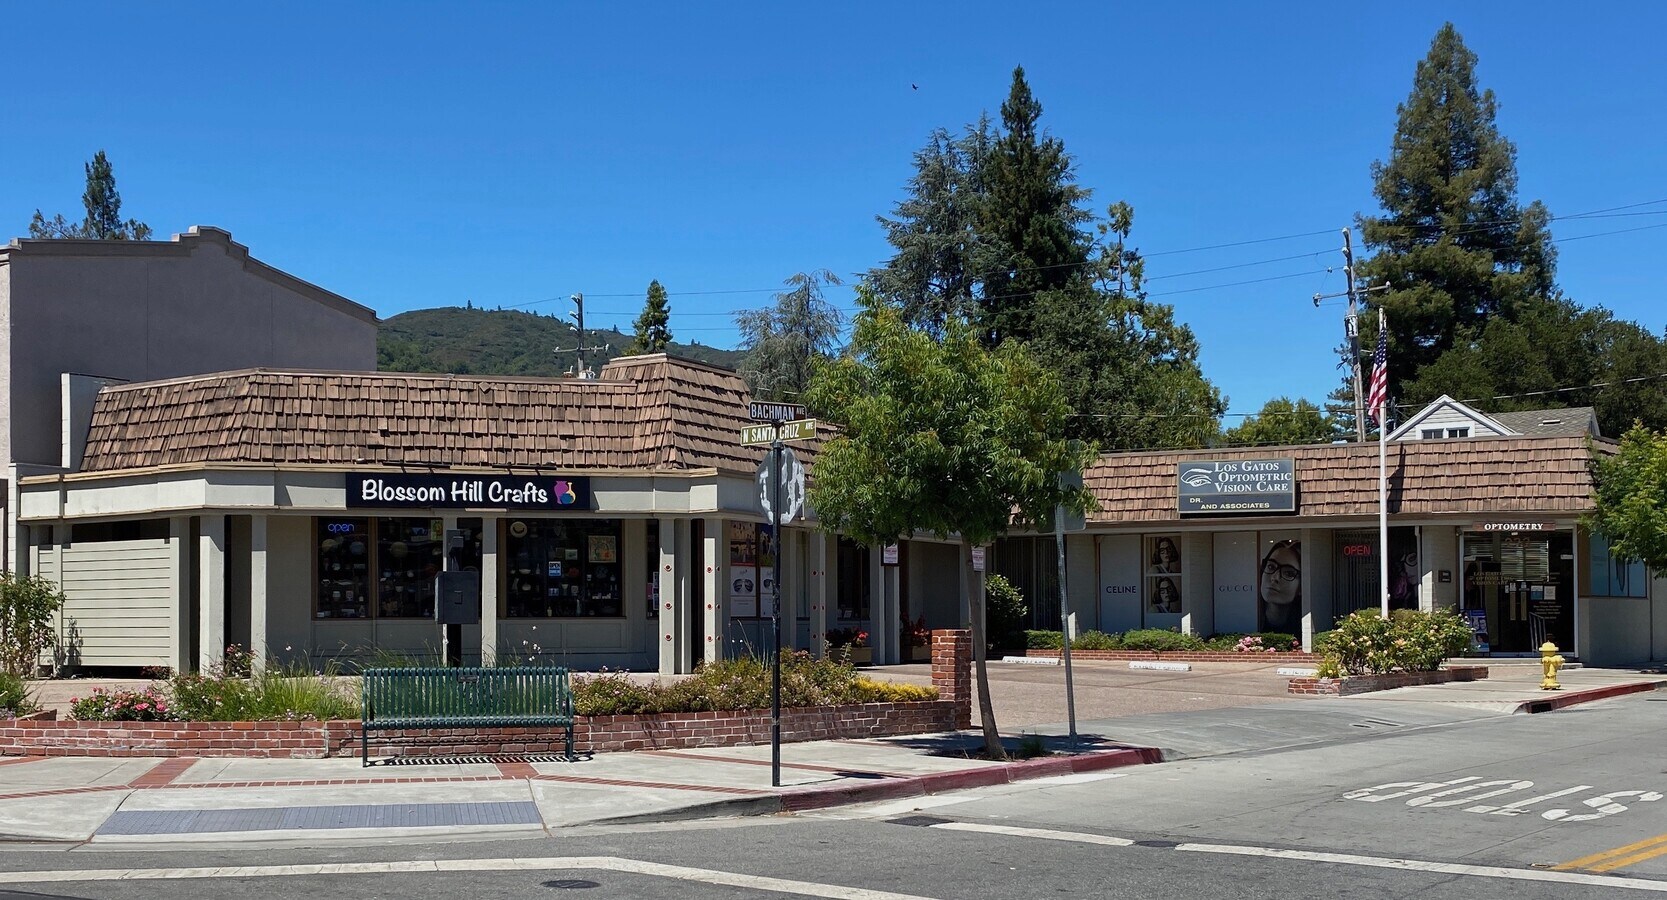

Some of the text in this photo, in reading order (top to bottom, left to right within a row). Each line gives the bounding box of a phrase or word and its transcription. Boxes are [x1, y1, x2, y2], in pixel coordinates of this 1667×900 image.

[751, 404, 805, 420] BACHMAN AVE
[743, 421, 813, 443] N SANTA CRUZ AVE
[1214, 461, 1280, 472] LOS GATOS
[1218, 472, 1292, 483] OPTOMETRIC
[361, 479, 548, 504] Blossom Hill Crafts
[1215, 481, 1289, 493] VISION CARE
[1220, 502, 1270, 510] ASSOCIATES
[327, 523, 355, 534] open
[1484, 523, 1544, 531] OPTOMETRY
[1343, 545, 1372, 556] OPEN
[1106, 585, 1137, 594] CELINE
[1218, 584, 1253, 593] GUCCI
[1343, 776, 1664, 822] STOP
